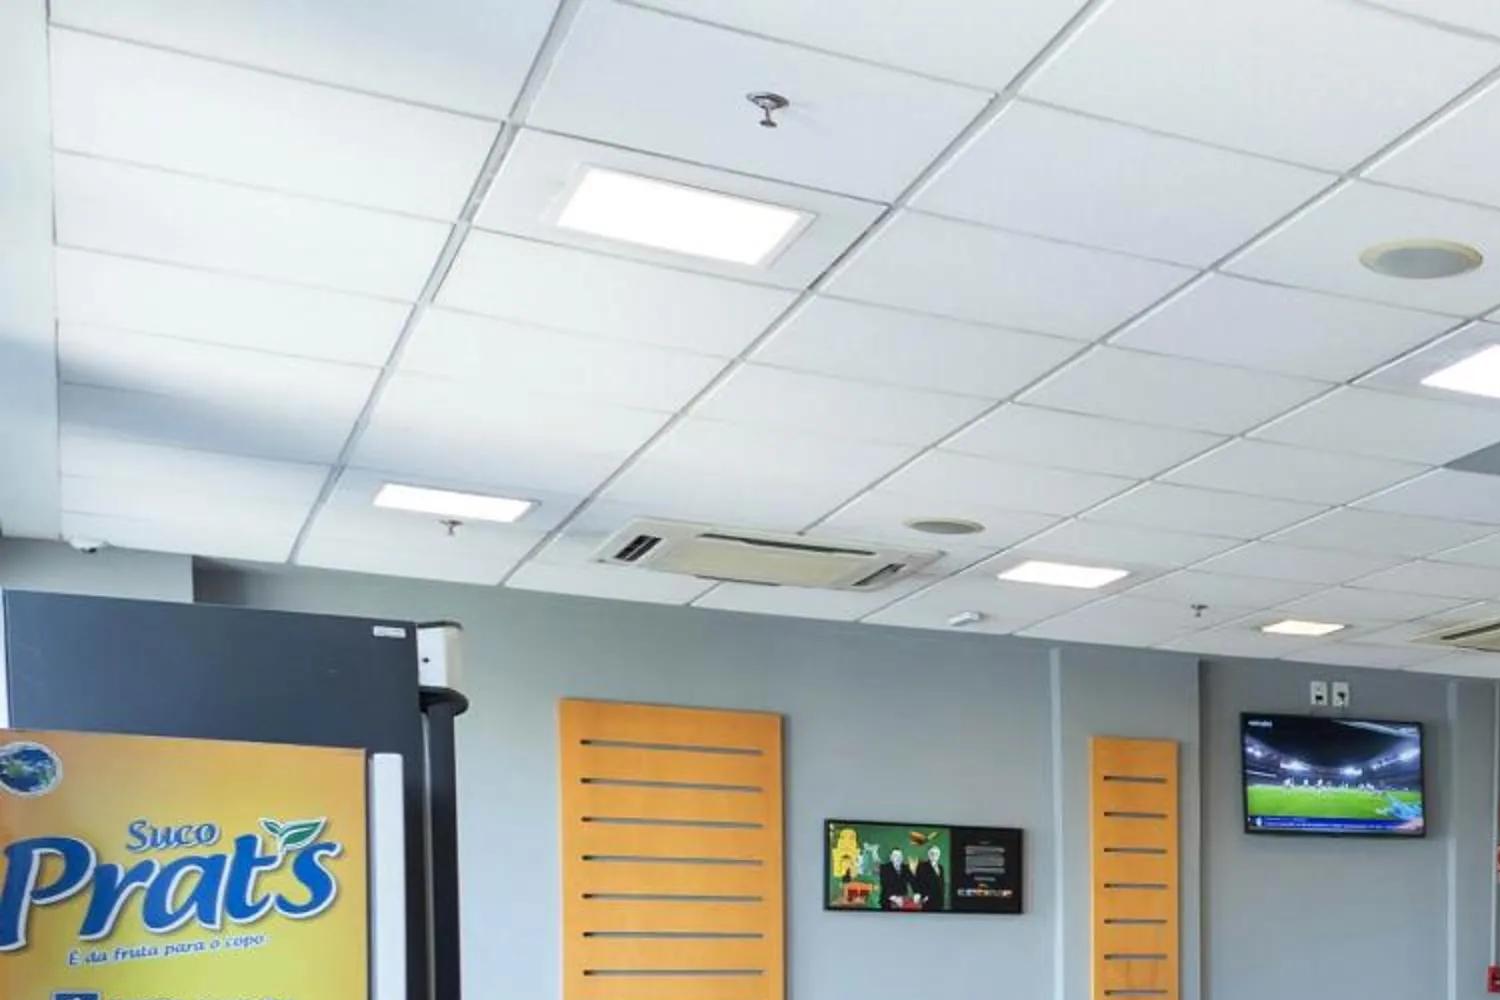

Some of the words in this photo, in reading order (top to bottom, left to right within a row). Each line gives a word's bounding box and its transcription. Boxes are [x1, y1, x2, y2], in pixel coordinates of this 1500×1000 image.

[126, 819, 220, 851] Suco
[85, 951, 107, 963] da
[114, 946, 158, 961] fruta
[164, 941, 205, 957] para
[210, 939, 221, 949] o
[225, 935, 264, 949] copo
